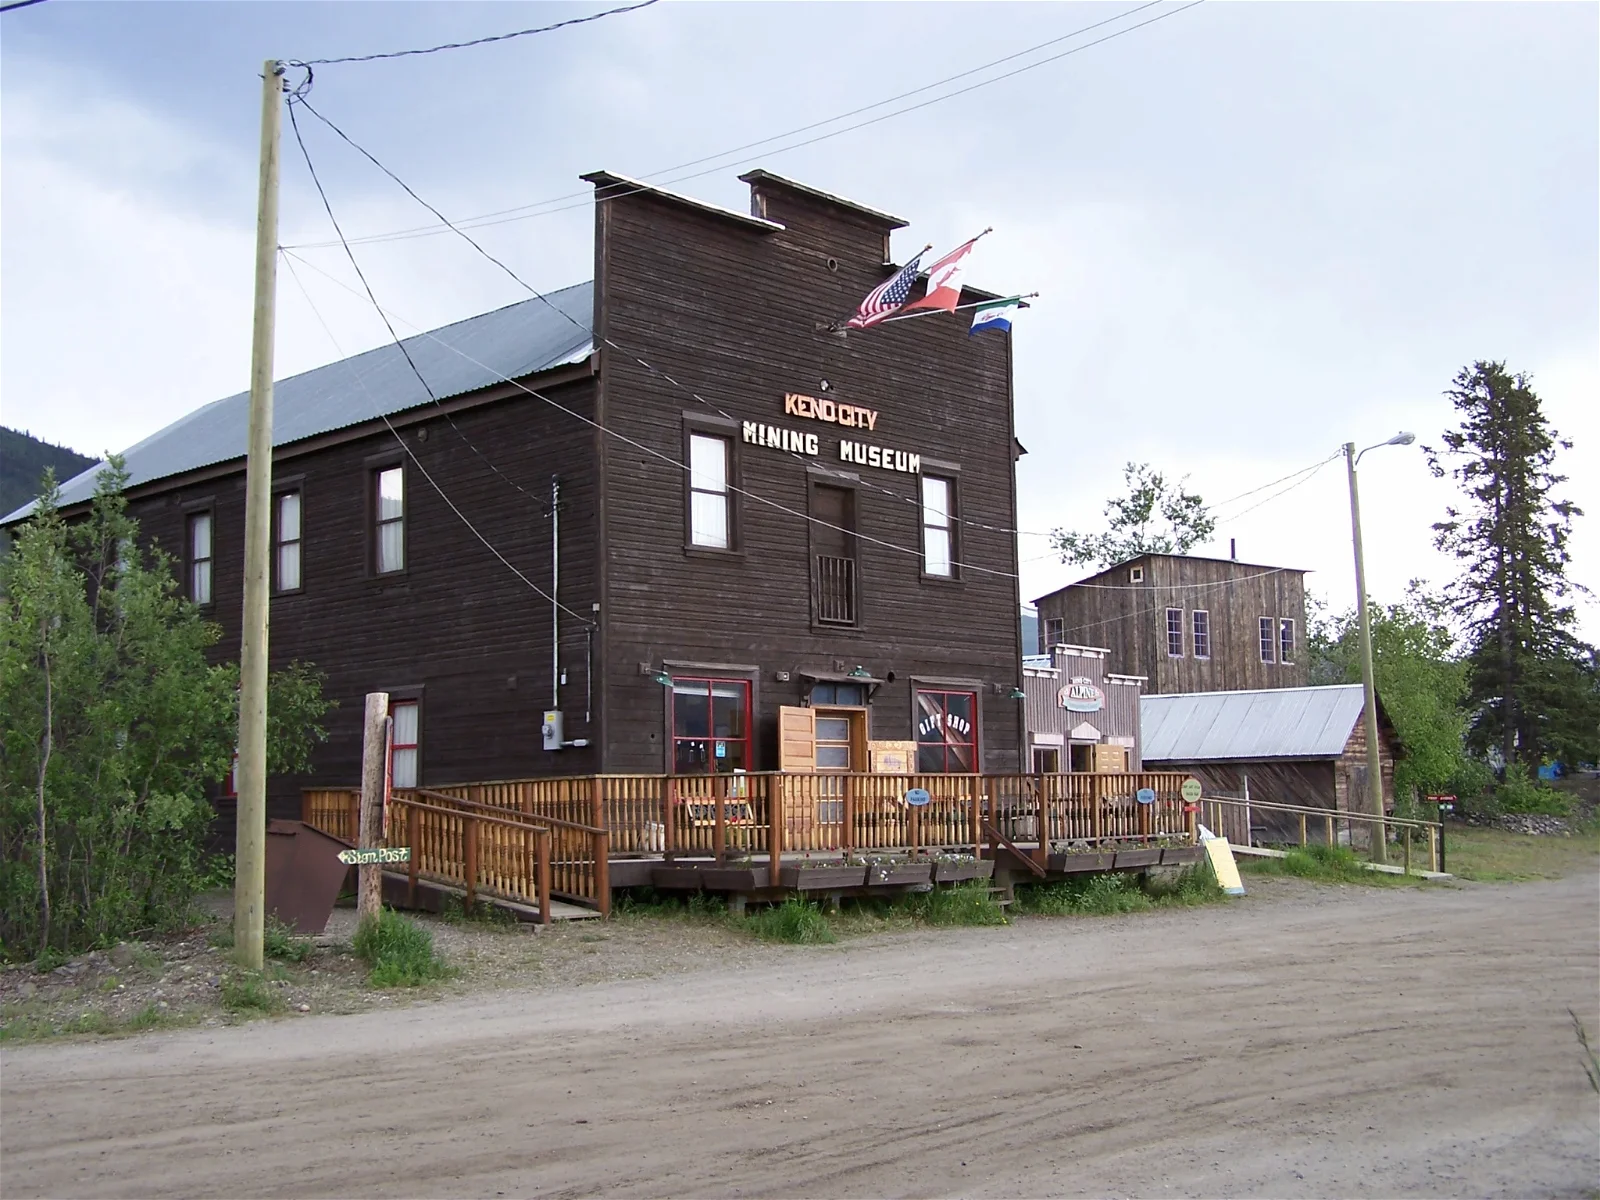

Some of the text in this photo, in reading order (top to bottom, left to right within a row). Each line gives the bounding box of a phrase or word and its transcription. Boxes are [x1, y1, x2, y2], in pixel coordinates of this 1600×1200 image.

[784, 392, 878, 431] KENO CITY
[742, 420, 921, 474] MINING MUSEUM
[947, 713, 971, 735] SHOP
[347, 847, 408, 865] Sign Post
